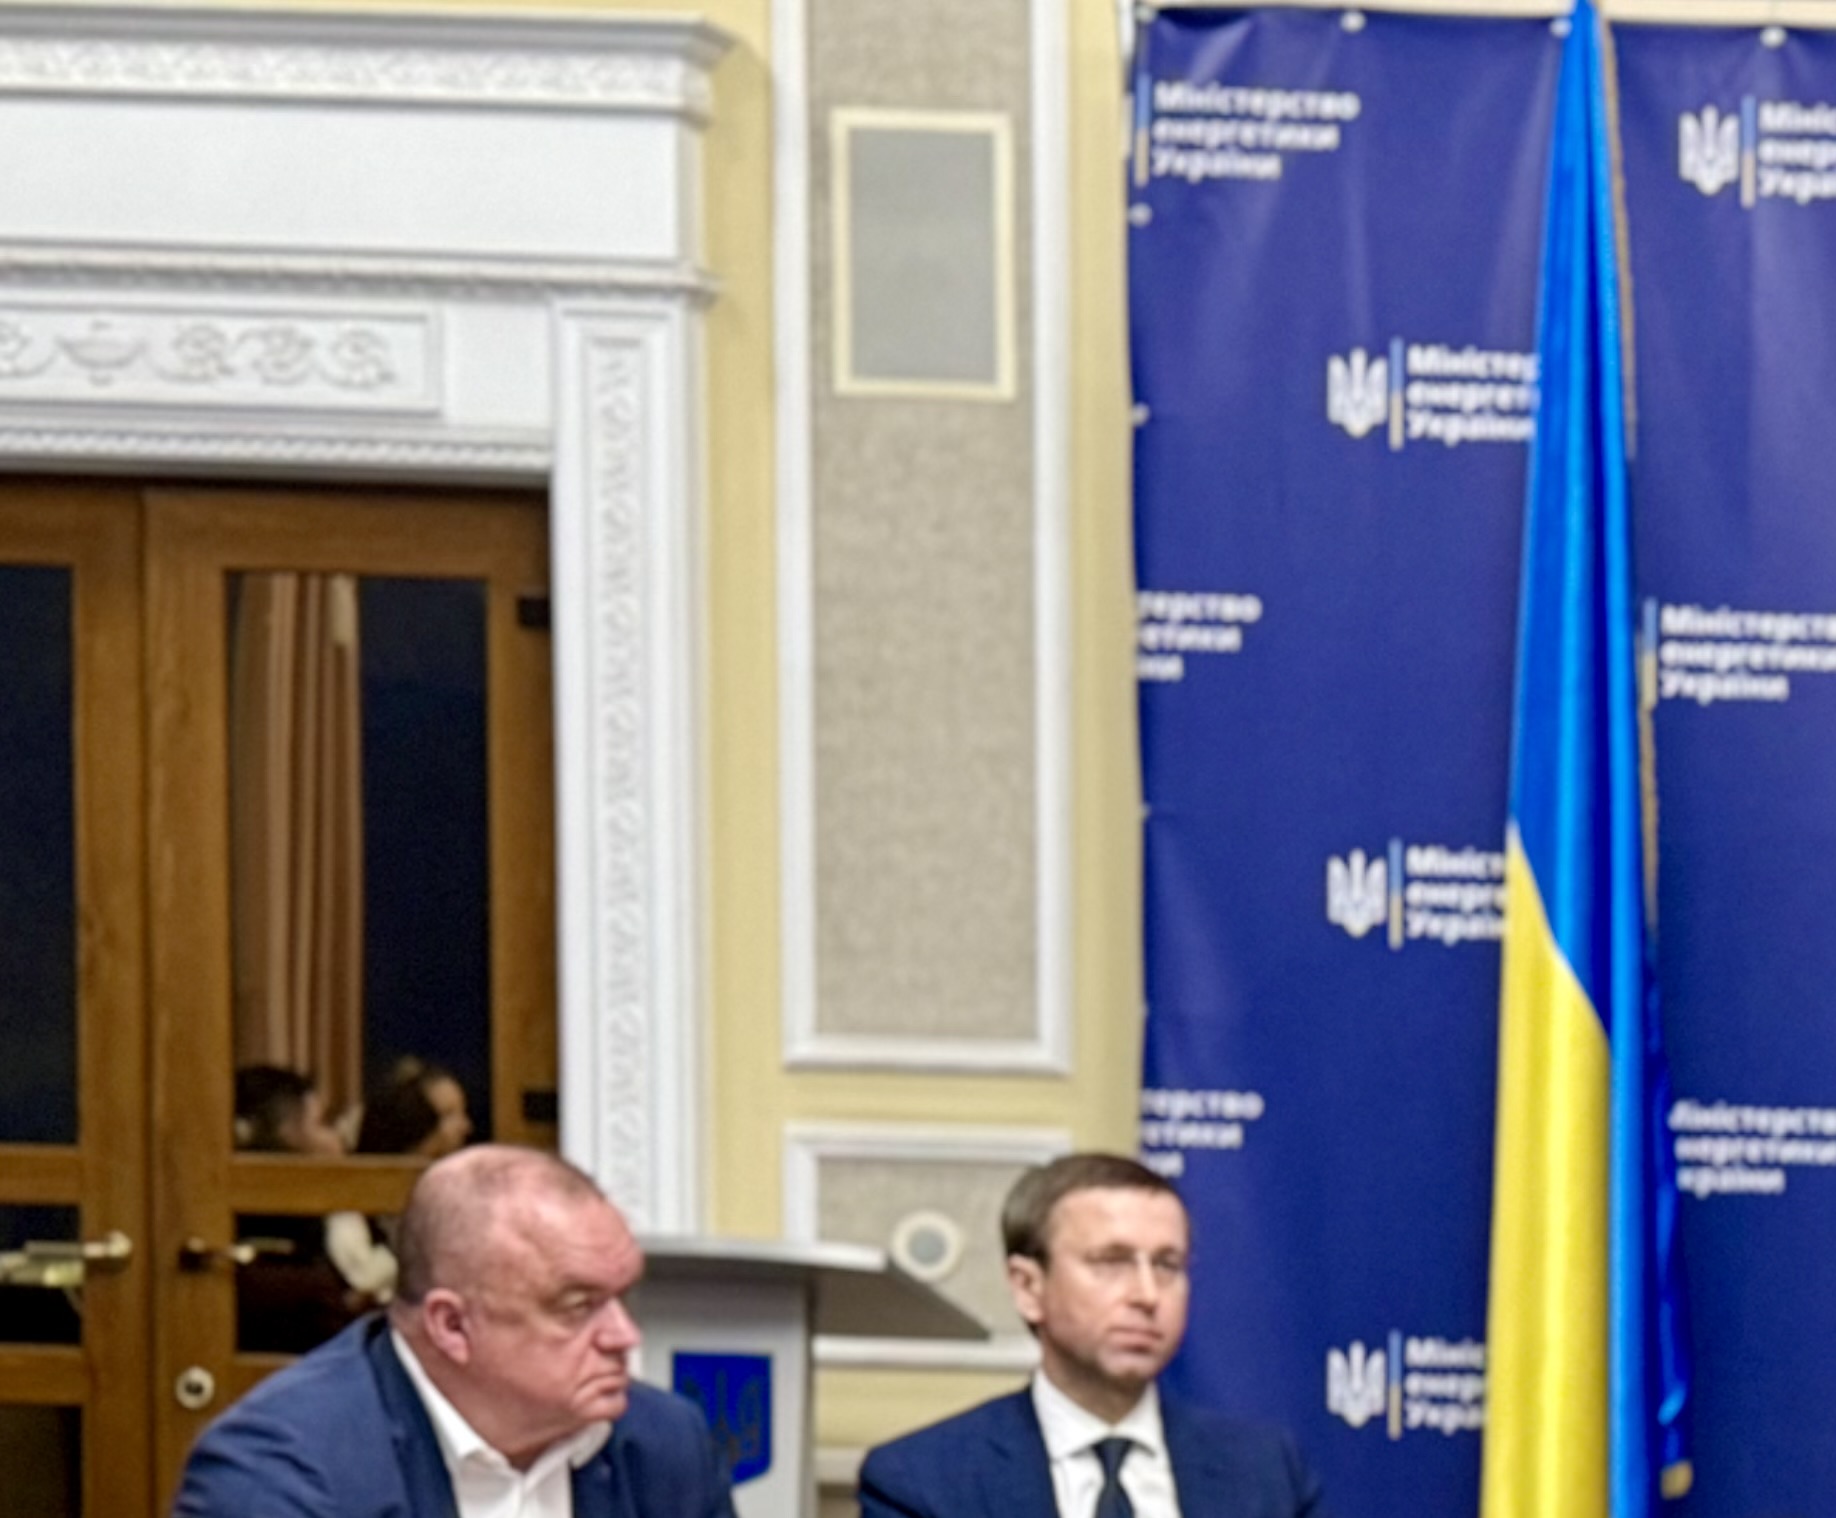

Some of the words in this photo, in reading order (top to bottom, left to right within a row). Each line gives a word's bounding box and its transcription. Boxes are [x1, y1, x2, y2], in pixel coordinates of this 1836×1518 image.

[1154, 82, 1360, 126] Міністерство
[1152, 122, 1339, 157] енергетики
[1152, 150, 1281, 181] України
[1660, 673, 1788, 704] України
[1676, 1163, 1787, 1200] країни
